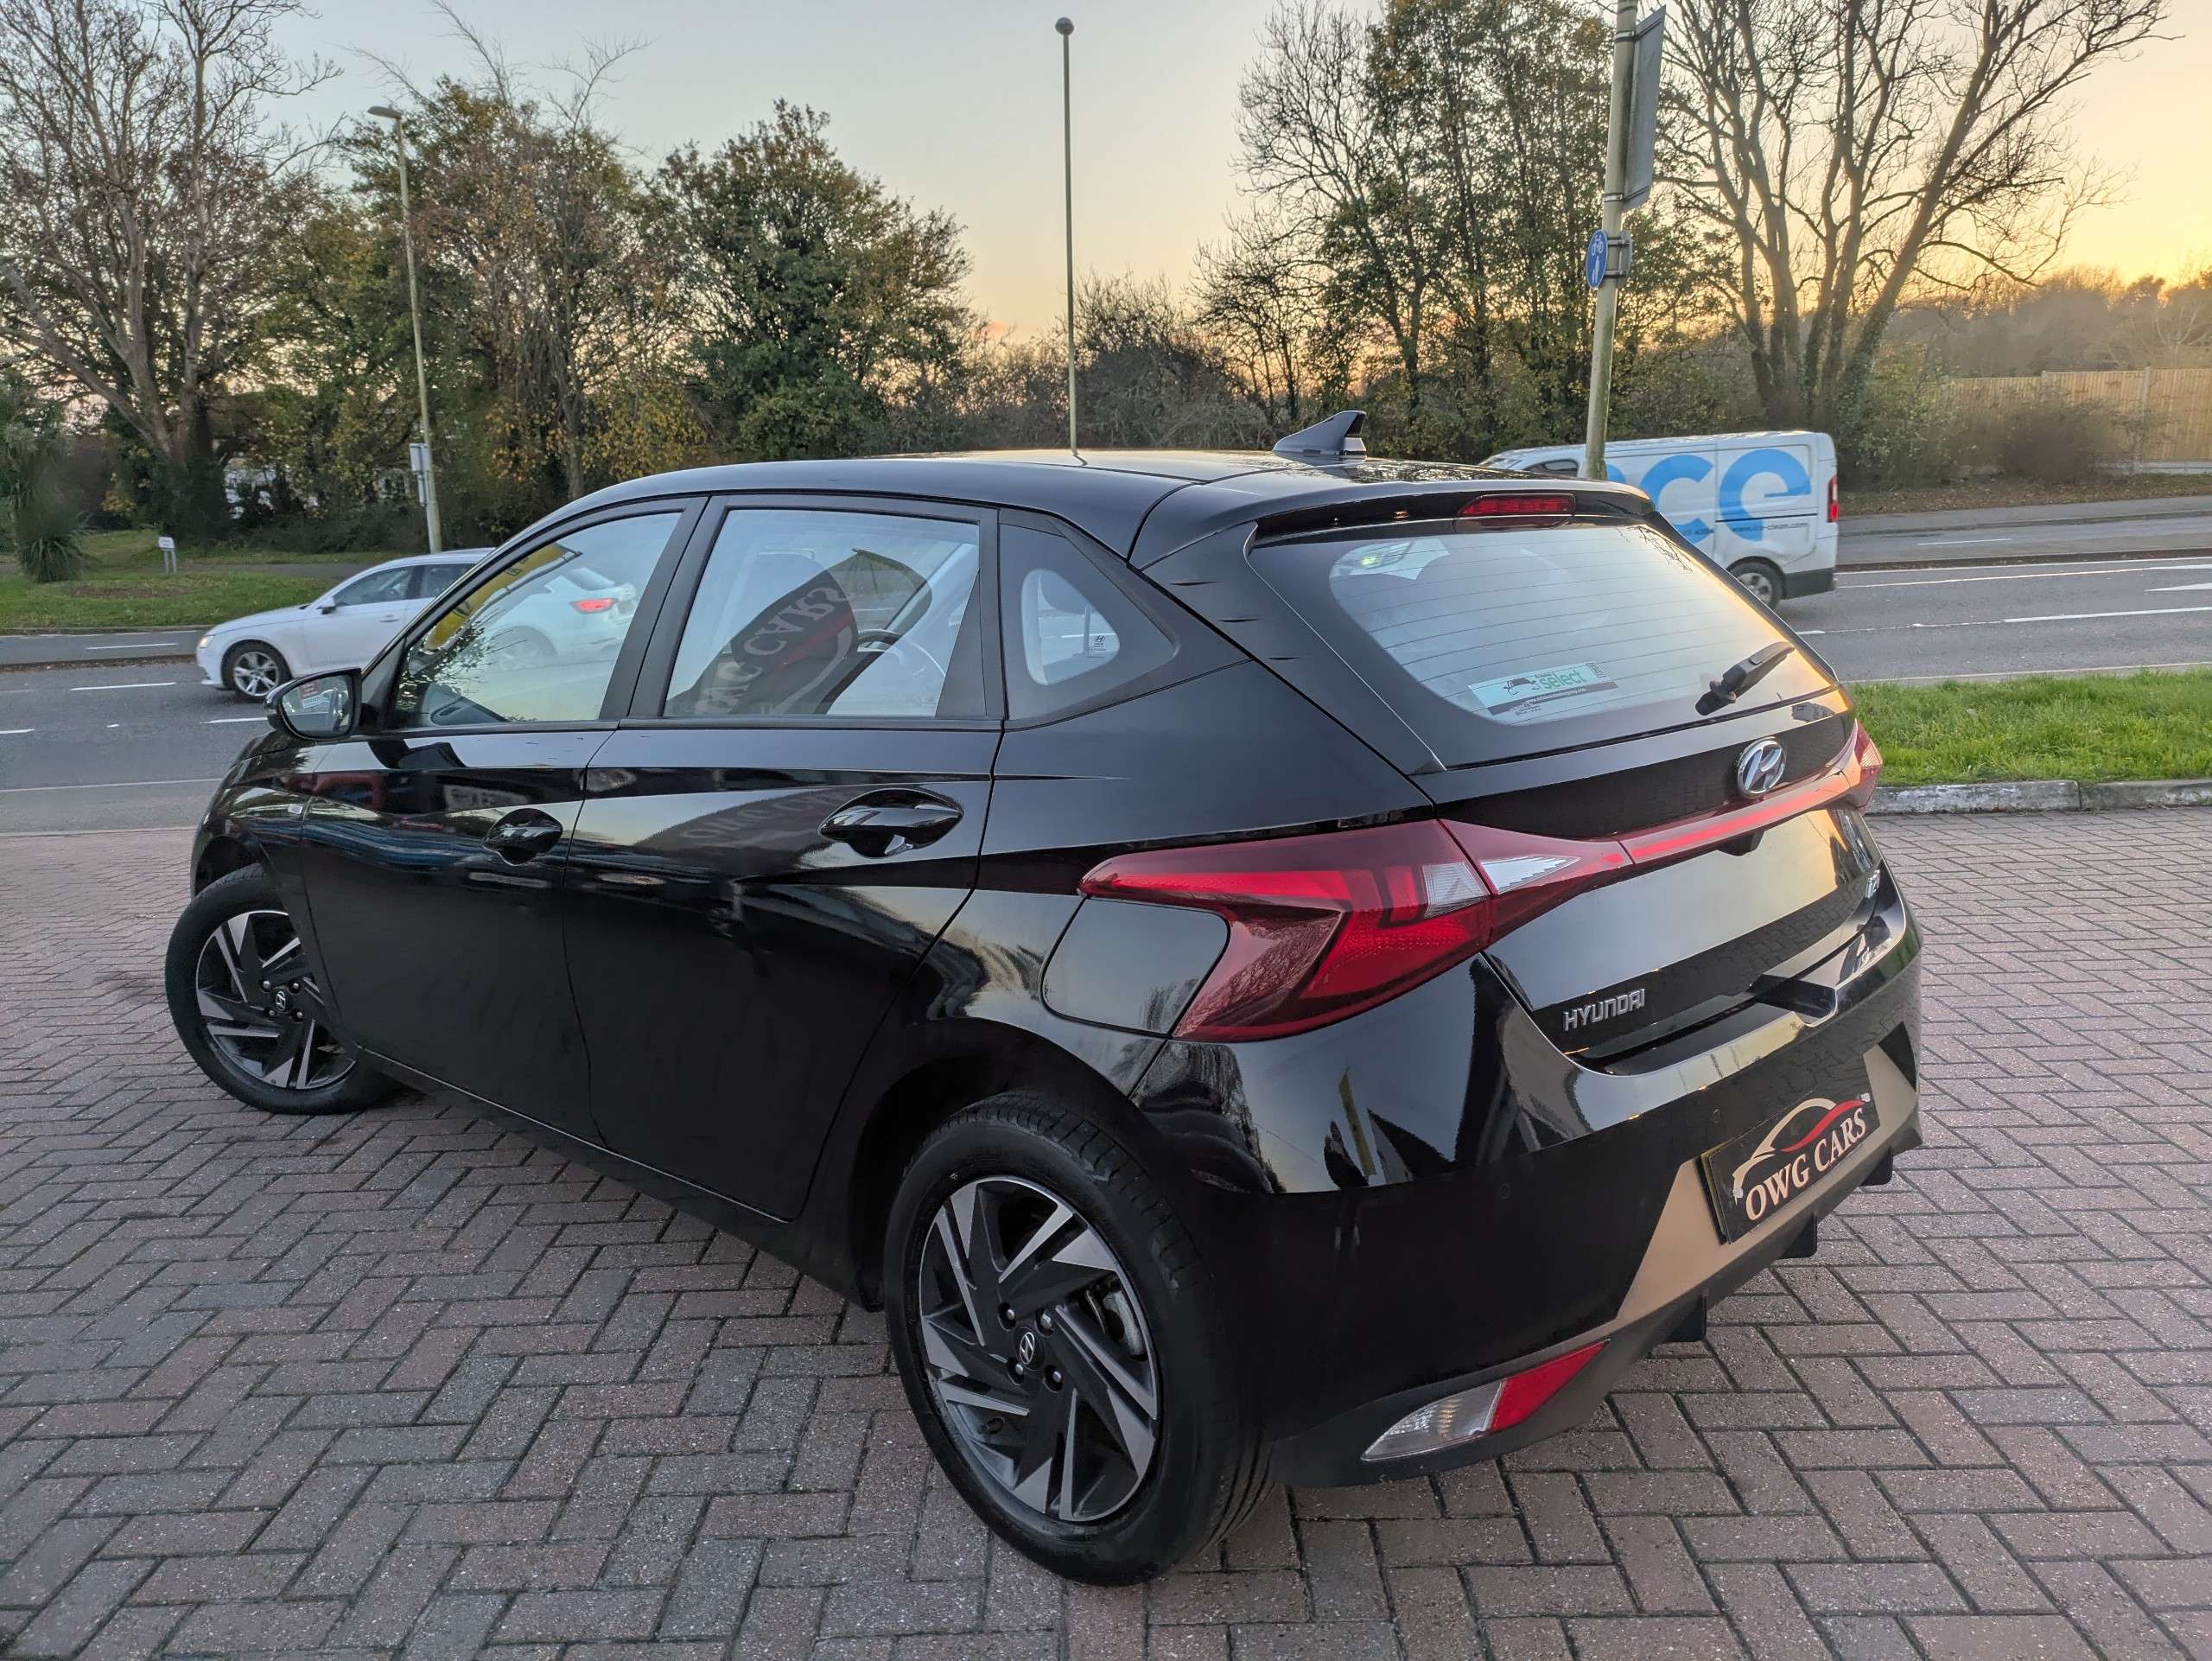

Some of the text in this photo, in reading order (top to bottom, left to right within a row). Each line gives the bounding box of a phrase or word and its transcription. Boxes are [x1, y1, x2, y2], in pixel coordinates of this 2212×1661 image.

[1606, 449, 1811, 543] ce
[1540, 671, 1587, 690] select
[1562, 989, 1645, 1031] HYUNDAI
[1745, 1108, 1867, 1220] OWG CARS
